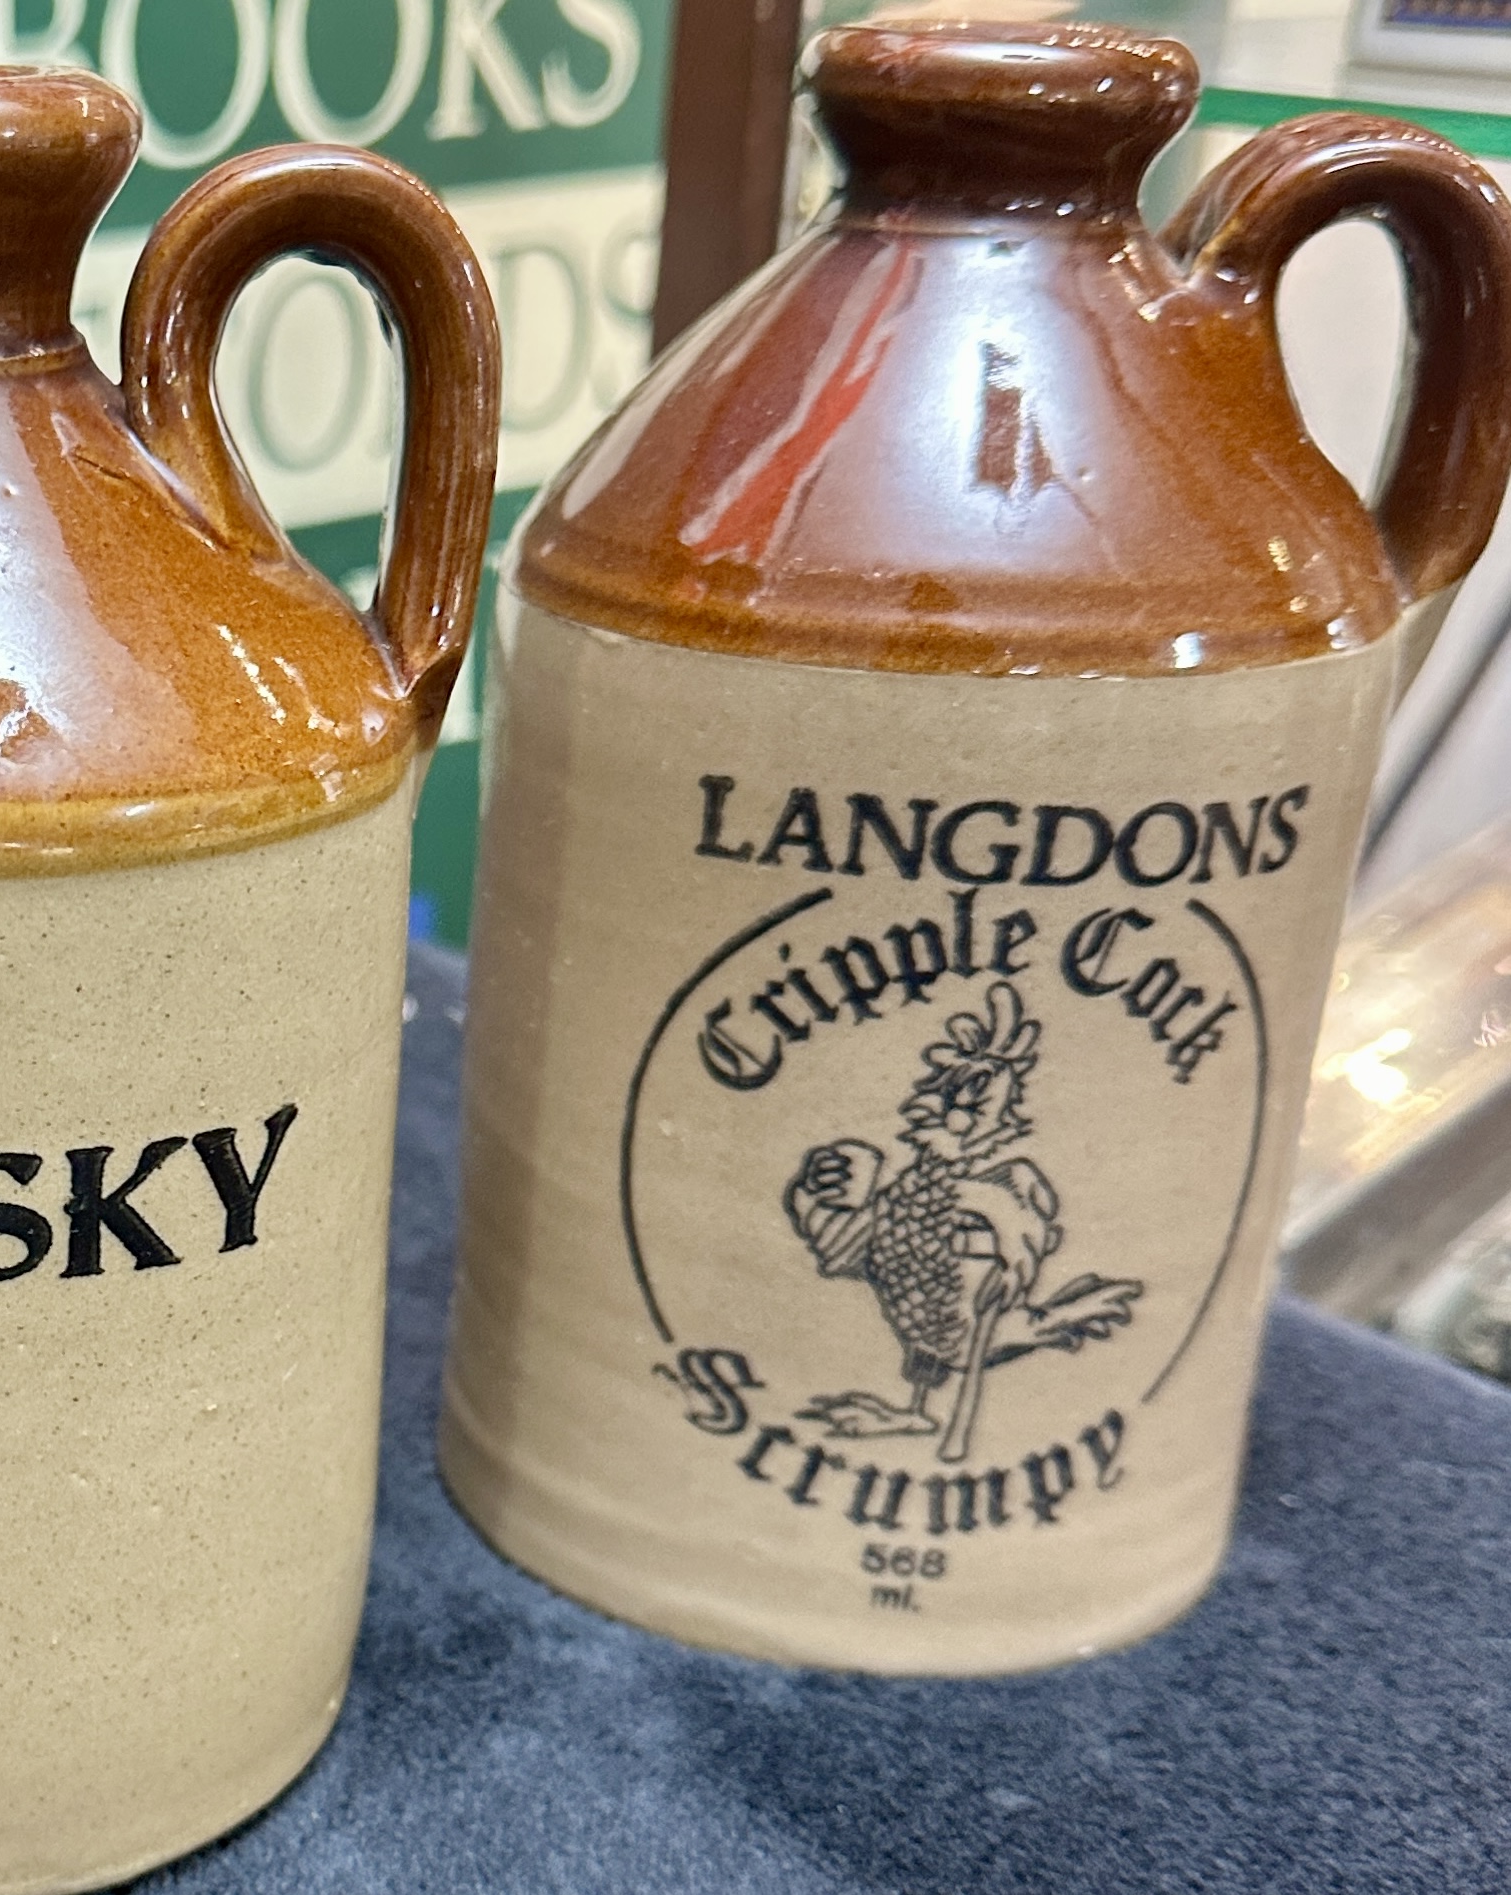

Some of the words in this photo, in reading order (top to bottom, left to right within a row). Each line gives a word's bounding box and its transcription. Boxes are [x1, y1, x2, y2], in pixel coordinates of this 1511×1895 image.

[695, 774, 1312, 888] LANGDONS
[697, 887, 1038, 1091] Cripple
[1060, 907, 1239, 1084] Cock
[651, 1348, 1126, 1536] Scrumpy
[860, 1543, 947, 1580] 568
